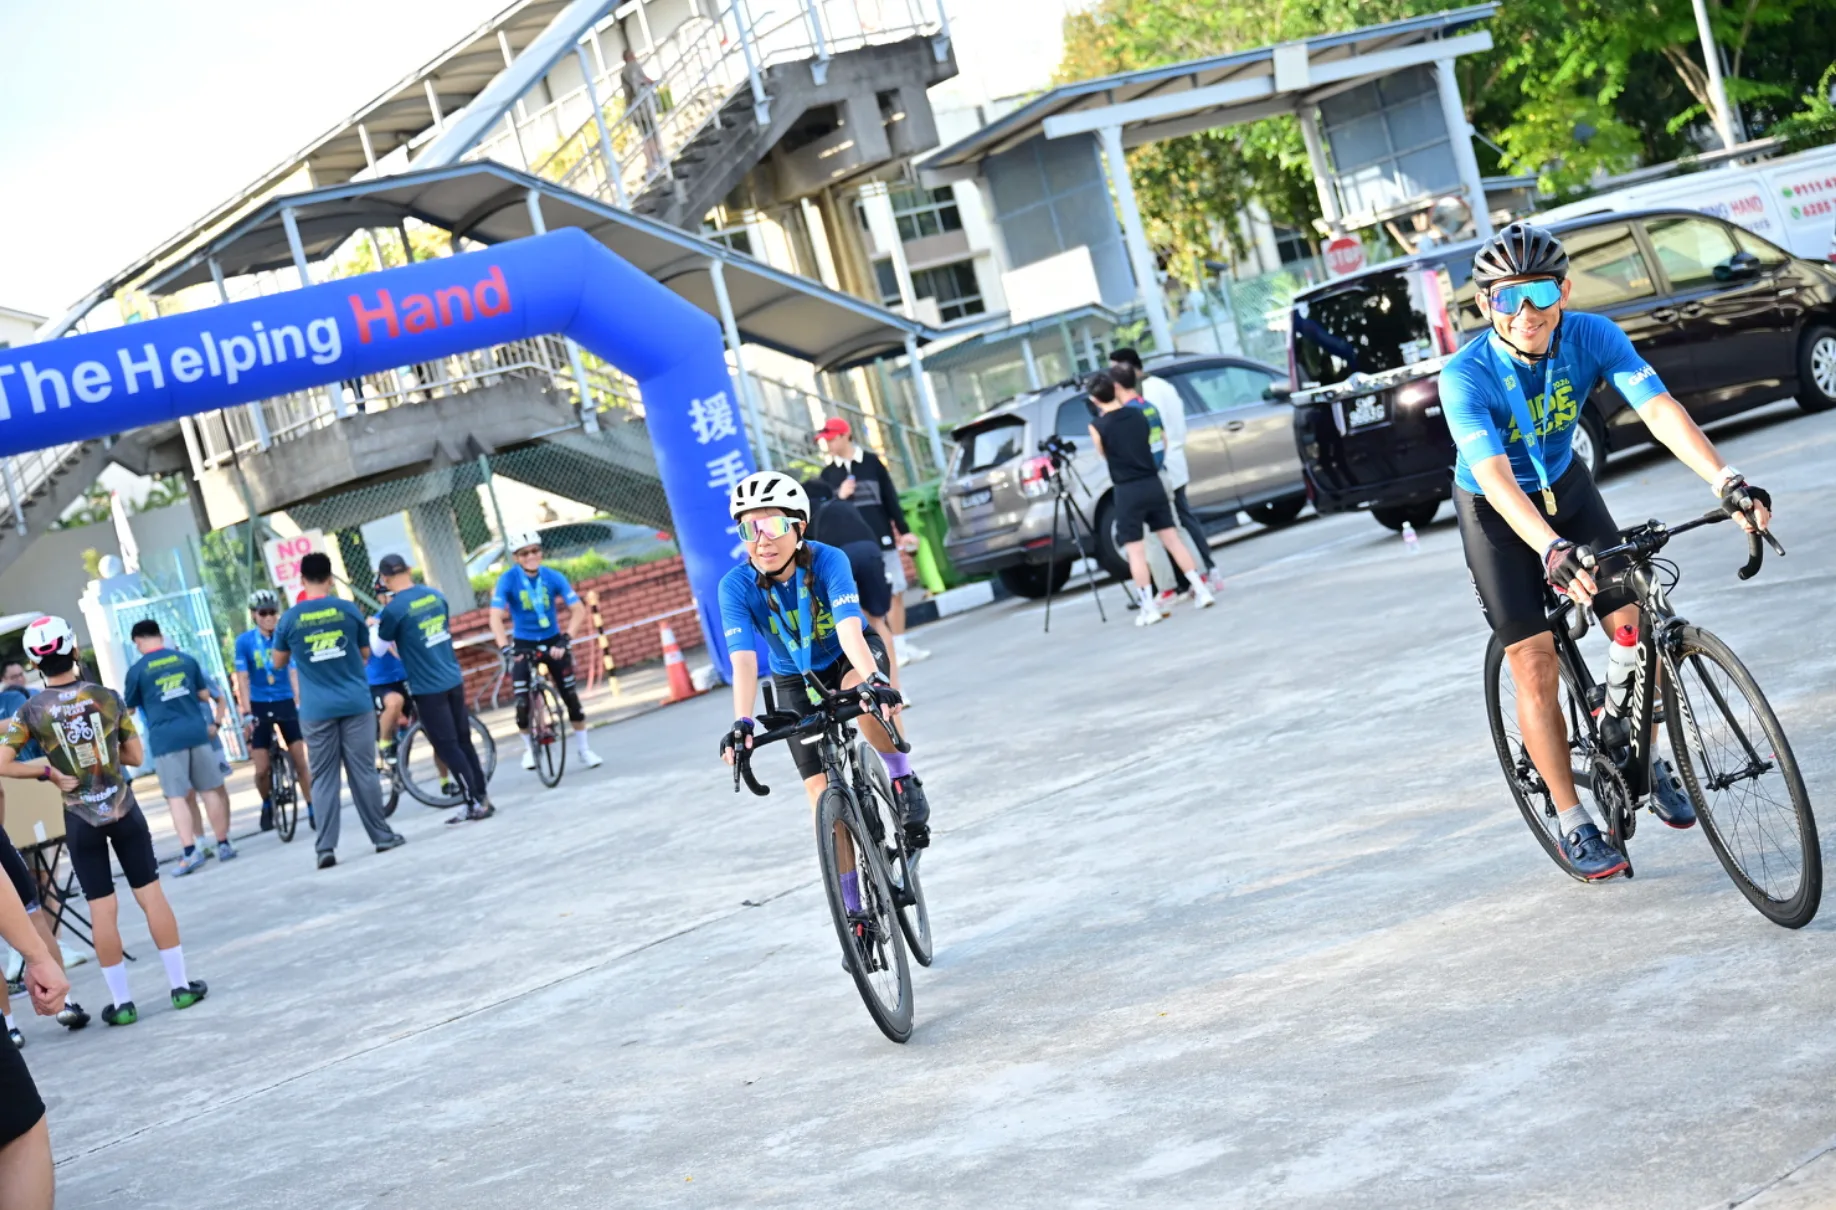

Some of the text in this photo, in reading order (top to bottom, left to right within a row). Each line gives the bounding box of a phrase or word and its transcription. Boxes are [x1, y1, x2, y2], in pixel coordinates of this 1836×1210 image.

[1730, 195, 1763, 216] HAND
[0, 265, 511, 421] The Helping Hand
[276, 536, 312, 559] NO
